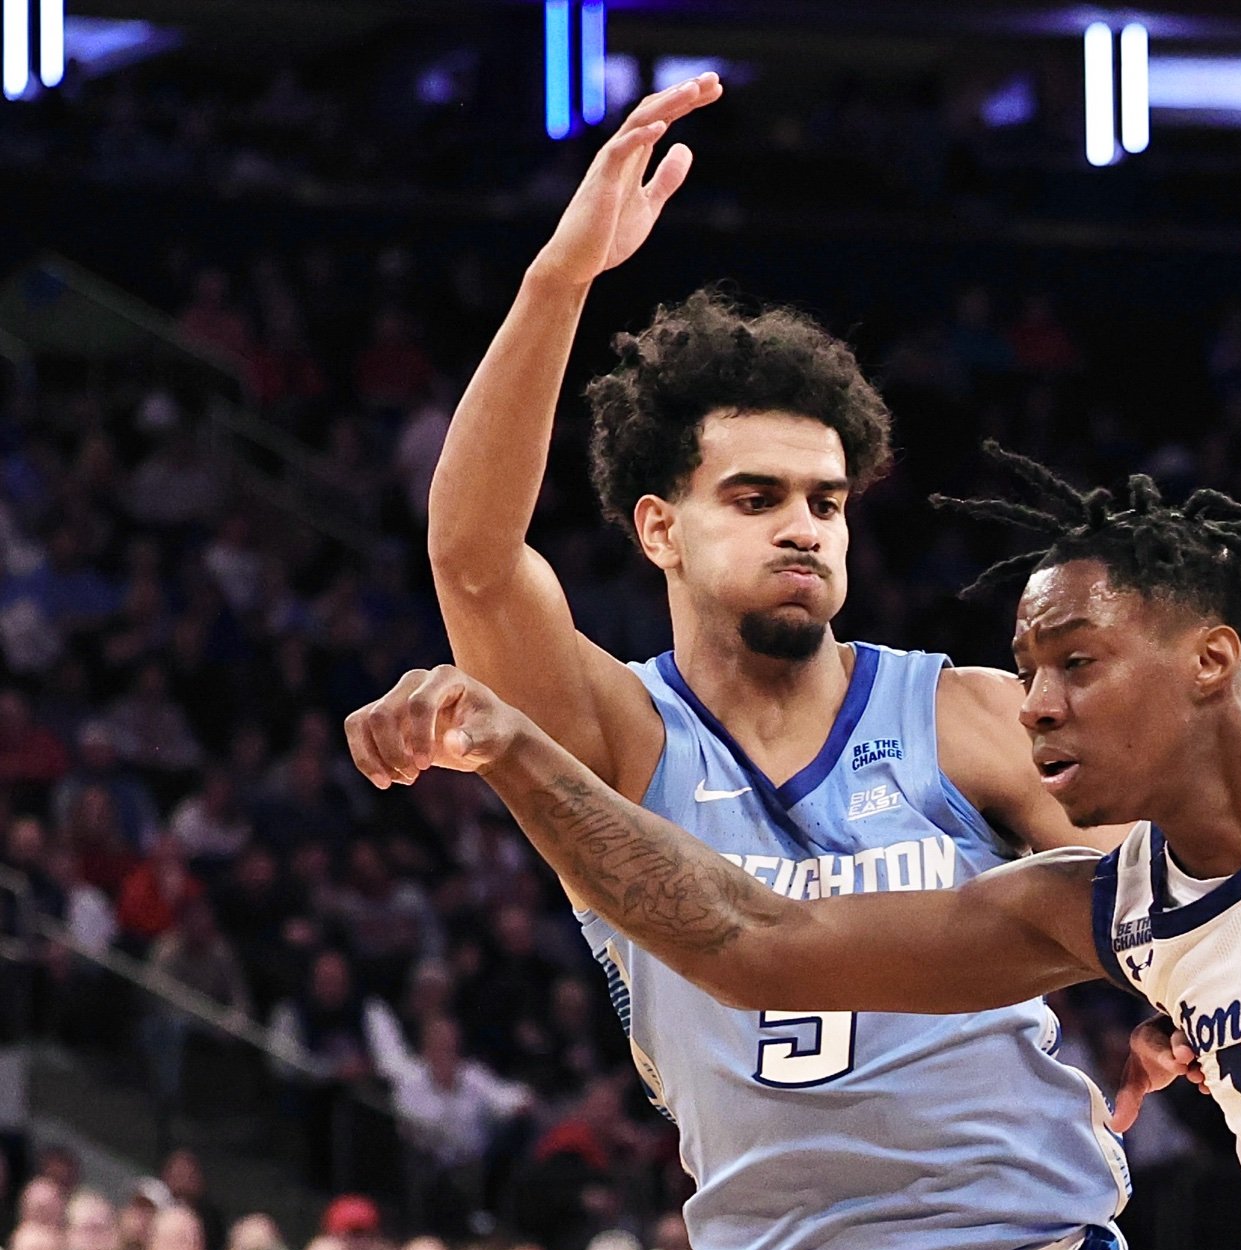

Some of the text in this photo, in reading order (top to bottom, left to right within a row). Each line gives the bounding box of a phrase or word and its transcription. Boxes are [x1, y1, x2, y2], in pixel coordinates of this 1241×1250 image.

[852, 748, 903, 771] CHANGE
[853, 739, 899, 757] BE THE
[848, 791, 901, 816] EAST
[850, 784, 887, 805] BIG
[719, 834, 956, 900] EIGHTON
[1116, 916, 1152, 937] BE TH
[1113, 928, 1153, 952] CHANG
